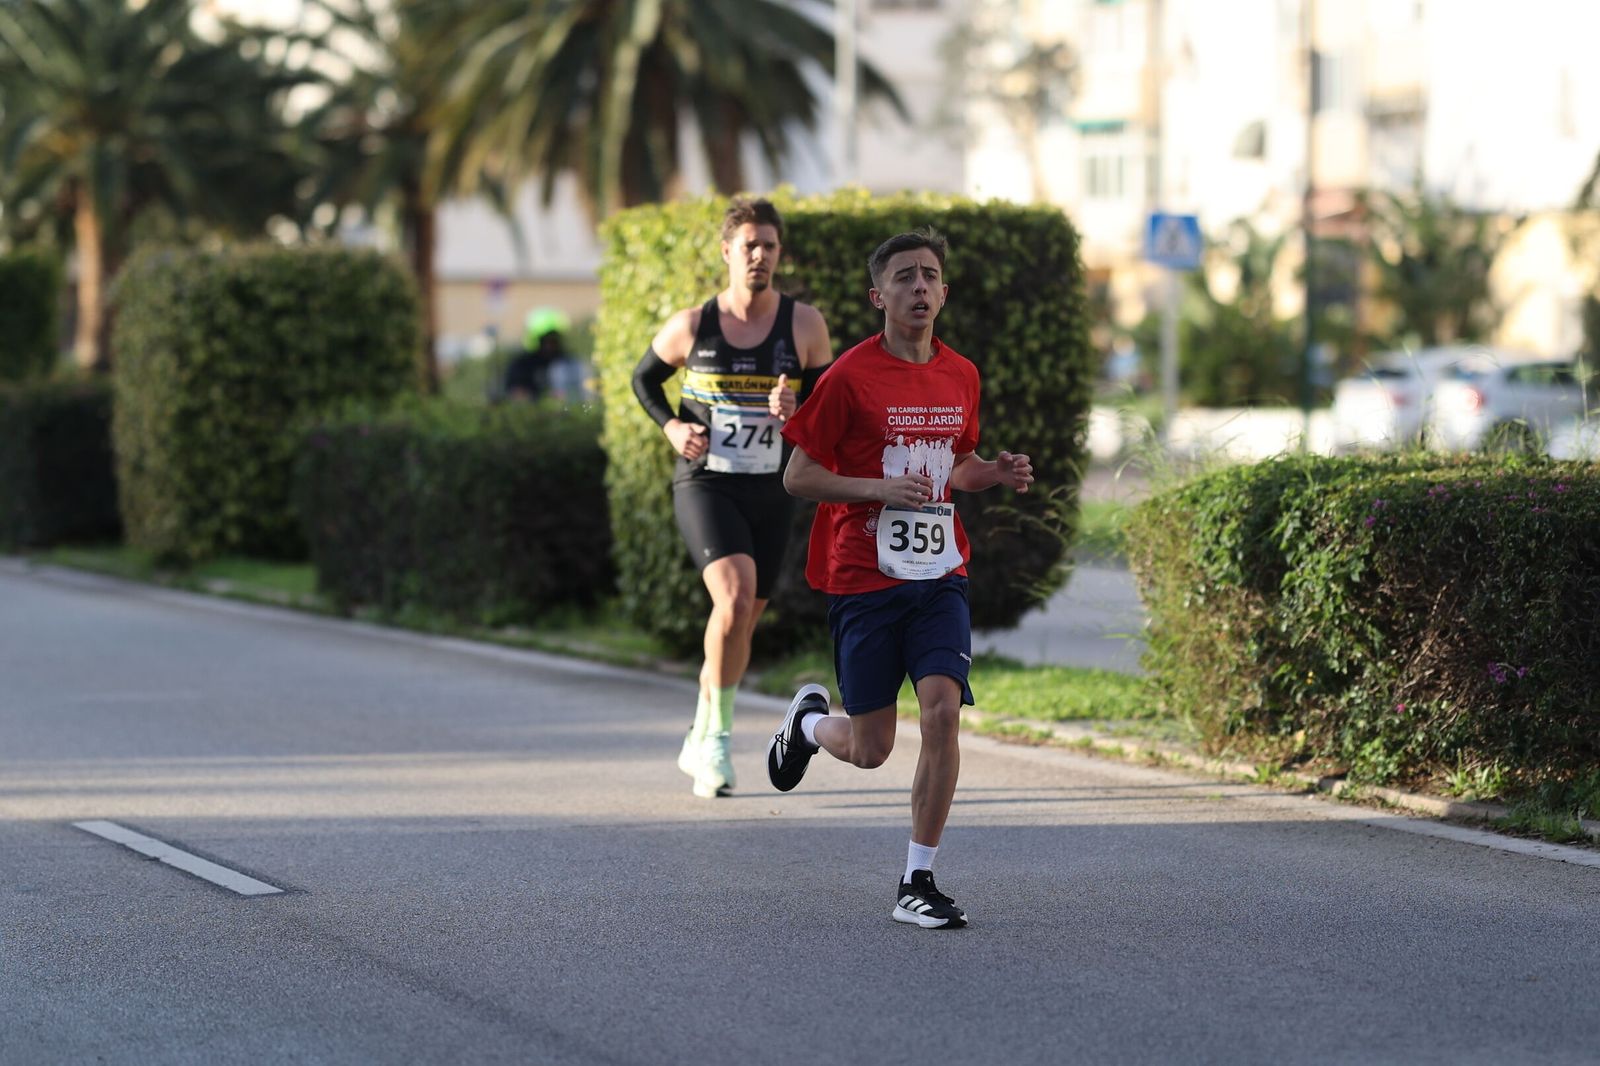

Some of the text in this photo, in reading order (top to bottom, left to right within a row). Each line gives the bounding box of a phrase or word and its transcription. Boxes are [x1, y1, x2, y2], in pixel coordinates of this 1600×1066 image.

[888, 413, 963, 425] CIUDAD JARDÍN
[722, 424, 774, 449] 274
[889, 519, 946, 555] 359
